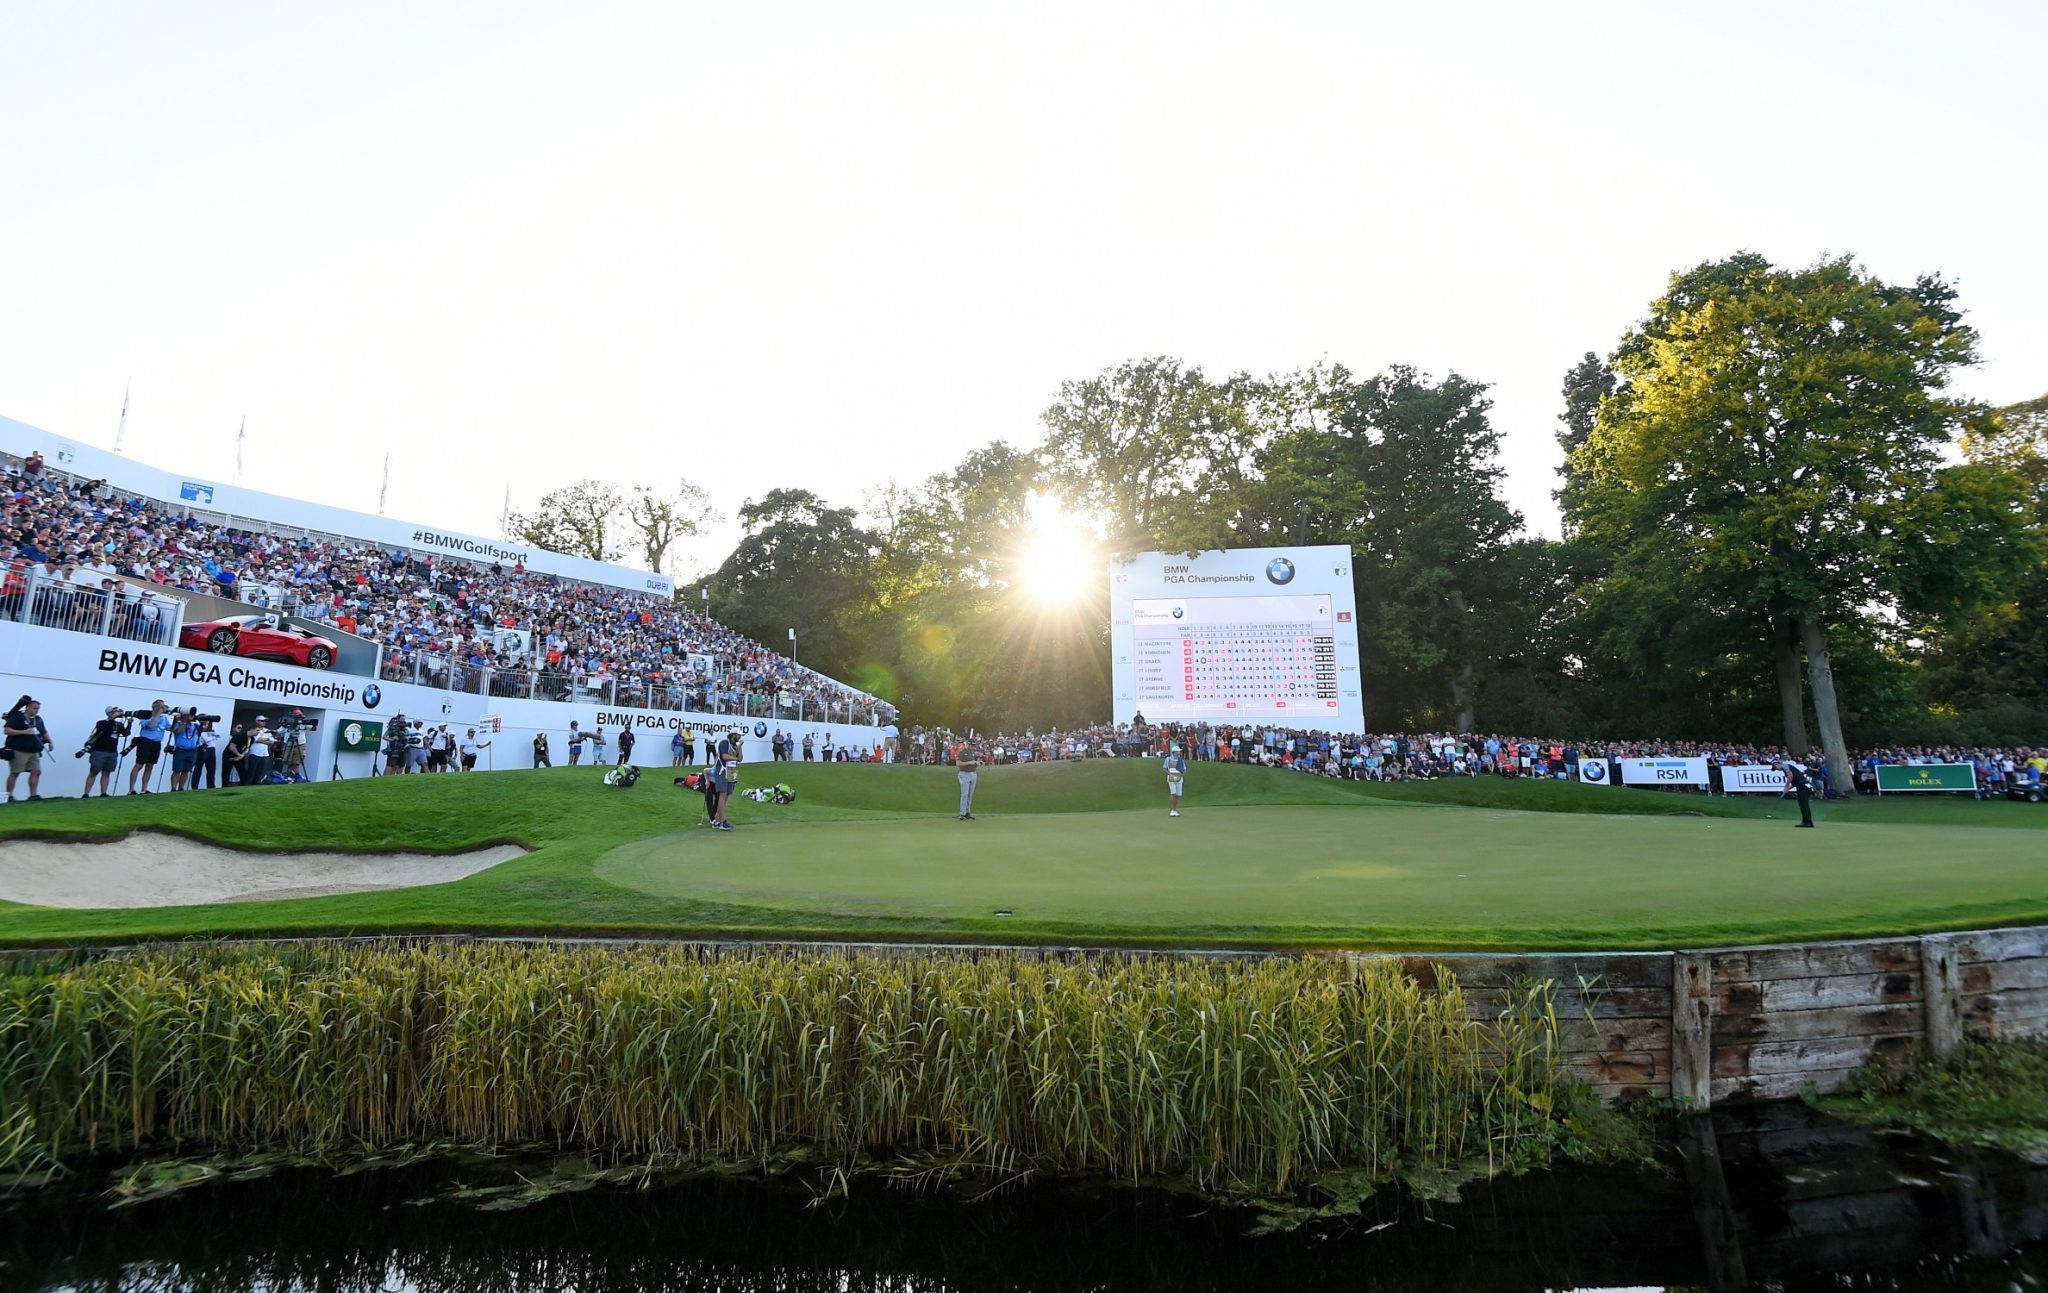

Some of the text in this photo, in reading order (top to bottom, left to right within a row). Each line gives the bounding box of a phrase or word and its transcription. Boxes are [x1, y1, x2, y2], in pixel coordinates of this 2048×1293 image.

[412, 531, 528, 563] #BMWGolfsport
[1164, 574, 1255, 584] PGA Championship
[98, 650, 355, 704] BMW PGA Championship
[596, 712, 633, 726] BMW
[636, 715, 665, 728] PGA
[1657, 770, 1688, 780] RSM
